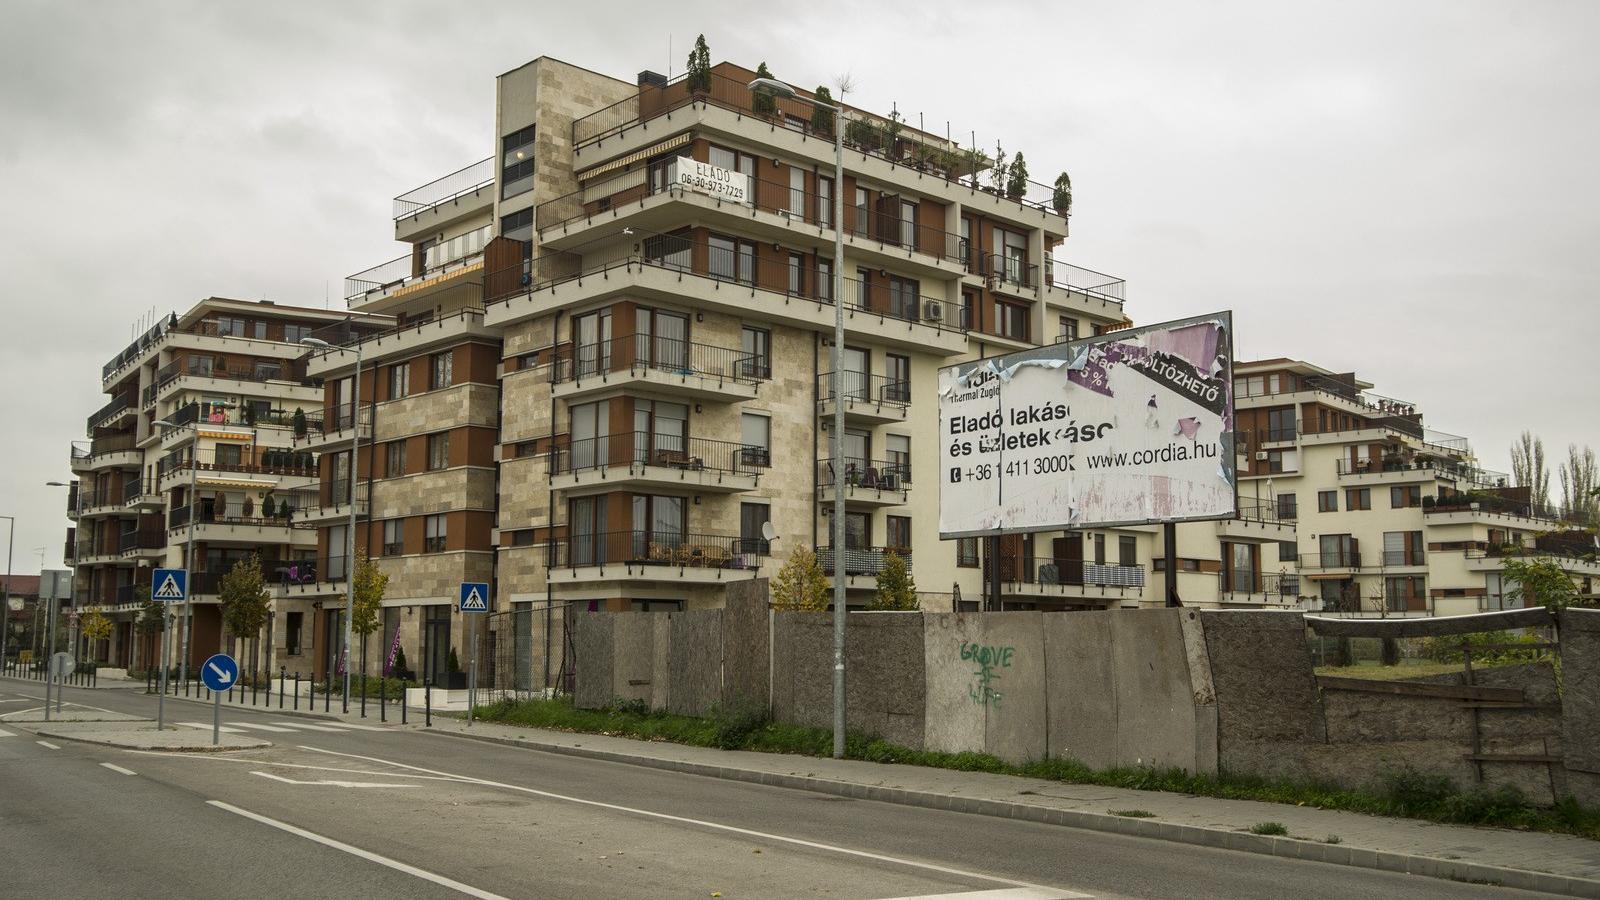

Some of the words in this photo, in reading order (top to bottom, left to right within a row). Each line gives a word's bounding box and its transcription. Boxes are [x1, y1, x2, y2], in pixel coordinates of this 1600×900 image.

[1091, 371, 1103, 386] %
[950, 409, 1003, 435] Eladó
[950, 438, 972, 457] és
[1086, 440, 1217, 469] www.cordia.hu
[965, 464, 992, 481] +36
[1005, 459, 1028, 477] 411
